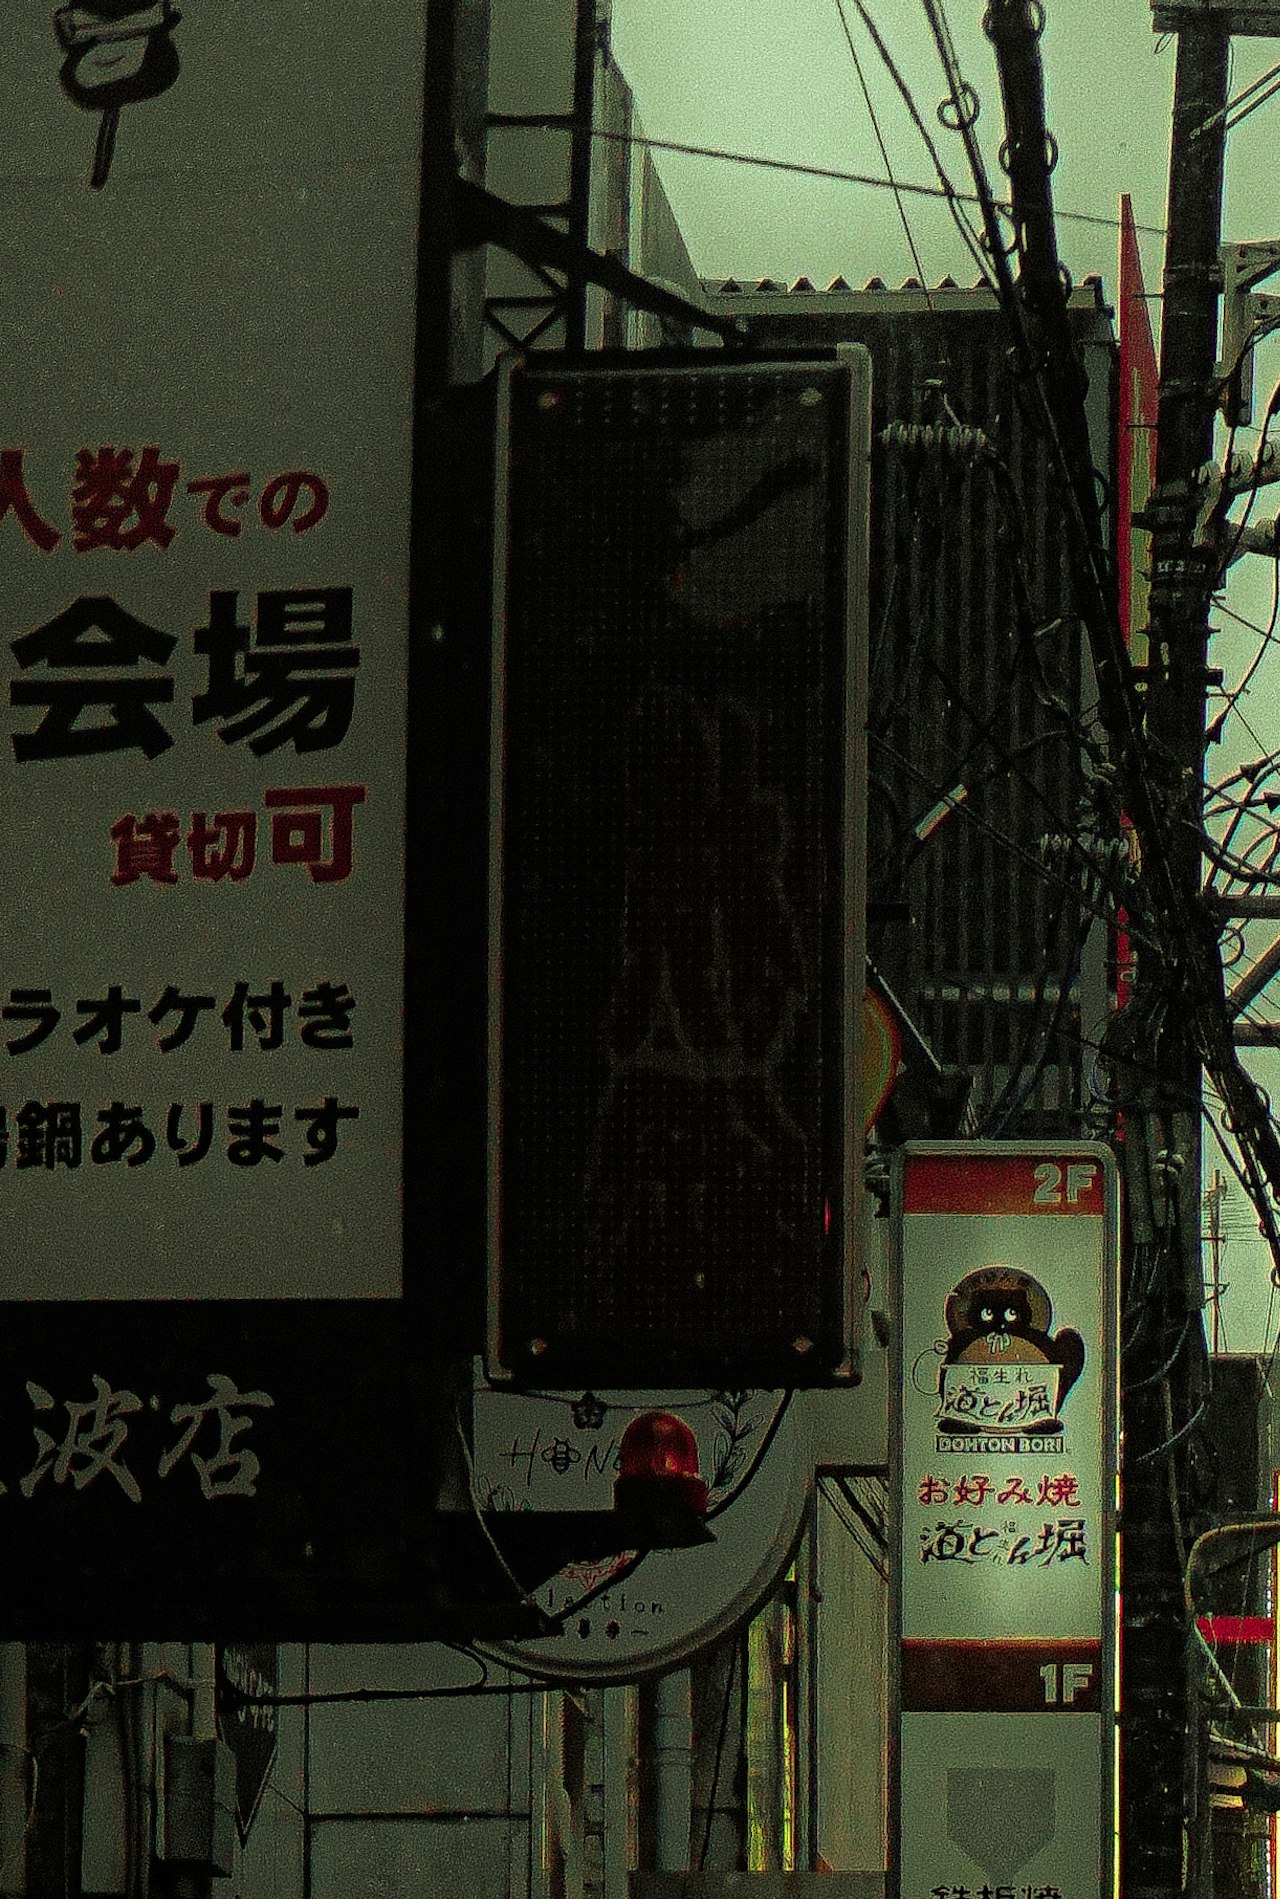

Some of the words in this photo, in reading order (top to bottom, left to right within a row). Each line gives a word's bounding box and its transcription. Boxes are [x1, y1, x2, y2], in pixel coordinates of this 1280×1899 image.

[10, 587, 360, 762] 会場
[111, 786, 365, 886] 貸切可
[0, 1098, 360, 1168] 鍋あります
[1033, 1163, 1098, 1204] 2F
[0, 1373, 275, 1503] 波店
[937, 1436, 1015, 1453] DOHTON
[1018, 1436, 1064, 1453] BORI
[918, 1473, 1082, 1507] お好み焼
[1038, 1663, 1095, 1704] 1F
